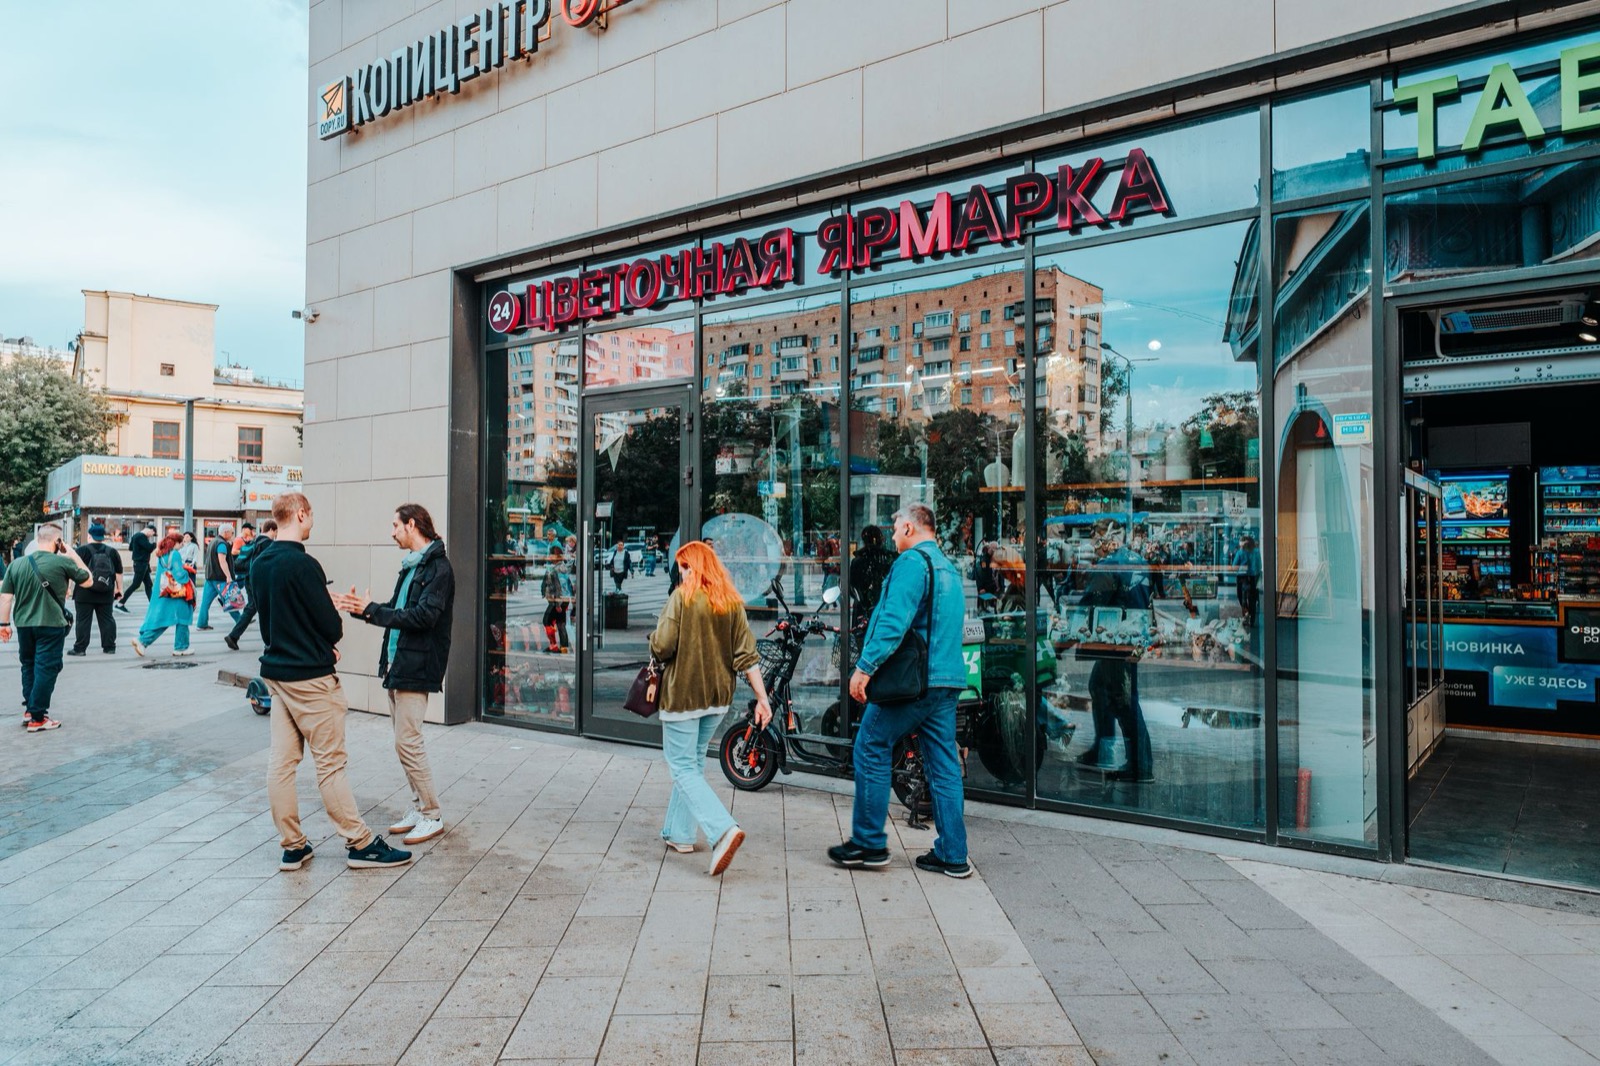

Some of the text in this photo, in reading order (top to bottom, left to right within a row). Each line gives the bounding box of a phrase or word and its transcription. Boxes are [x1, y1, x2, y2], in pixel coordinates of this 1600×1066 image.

[353, 0, 549, 126] КОПИЦЕНТР
[320, 114, 345, 135] COPY.RU
[492, 147, 1169, 332] 24 ЦВЕТОЧНАЯ ЯРМАРКА
[1445, 640, 1525, 655] НОВИНКА
[1504, 674, 1588, 689] УЖЕ ЗДЕСЬ
